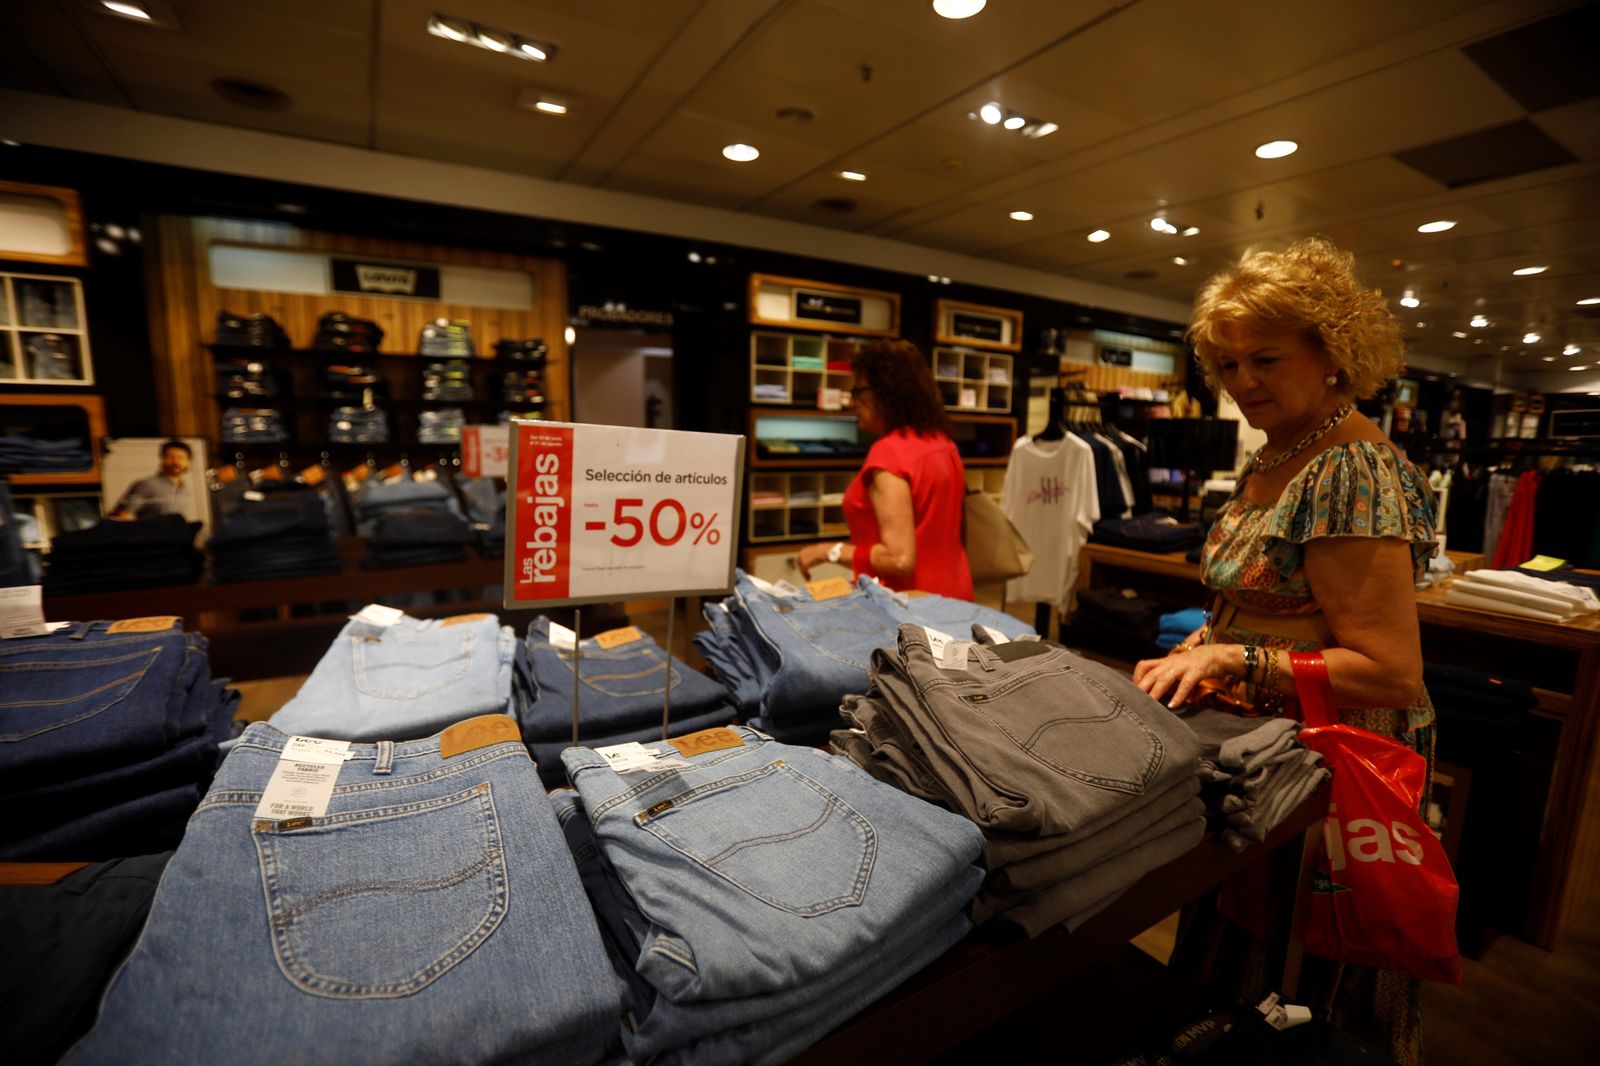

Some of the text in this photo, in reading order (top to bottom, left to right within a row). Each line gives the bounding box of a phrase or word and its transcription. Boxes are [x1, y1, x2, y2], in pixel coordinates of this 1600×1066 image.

[585, 468, 728, 485] Selección de artículos
[526, 453, 565, 583] rebajas
[585, 498, 721, 548] -50%
[520, 557, 533, 584] Las
